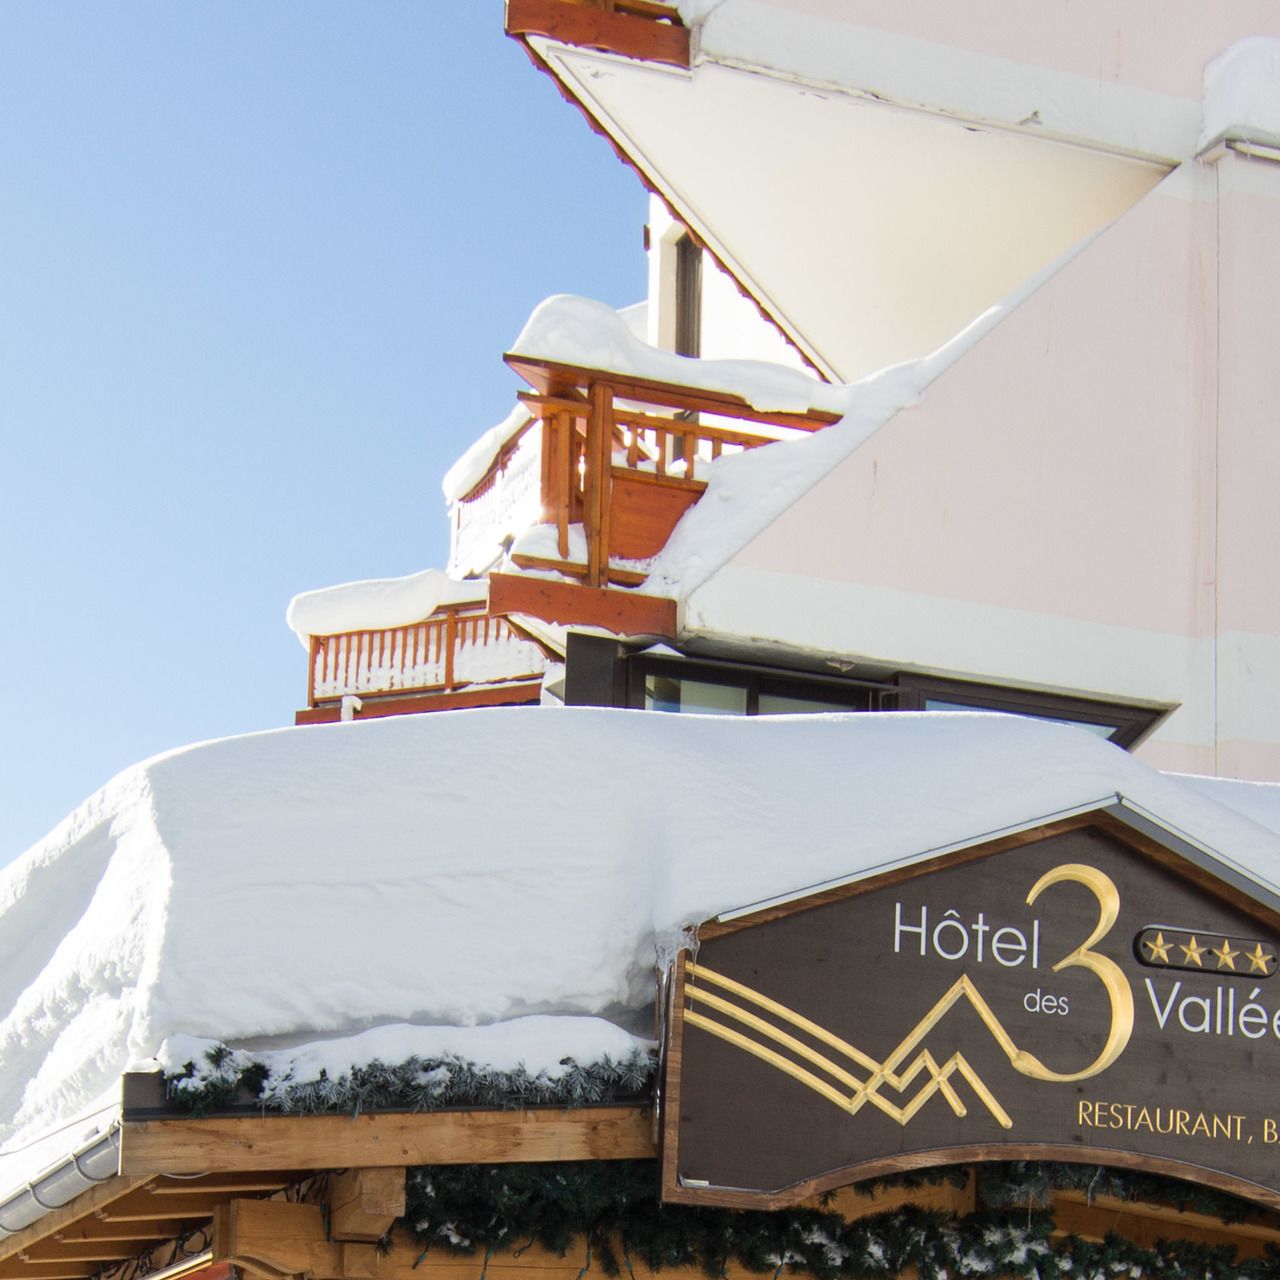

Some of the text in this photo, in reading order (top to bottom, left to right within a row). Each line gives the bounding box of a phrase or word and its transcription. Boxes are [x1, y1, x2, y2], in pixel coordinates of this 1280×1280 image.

[894, 902, 1039, 969] Hôtel
[1011, 863, 1135, 1082] 3
[1023, 988, 1070, 1016] des
[1078, 1100, 1254, 1145] RESTAURANT,
